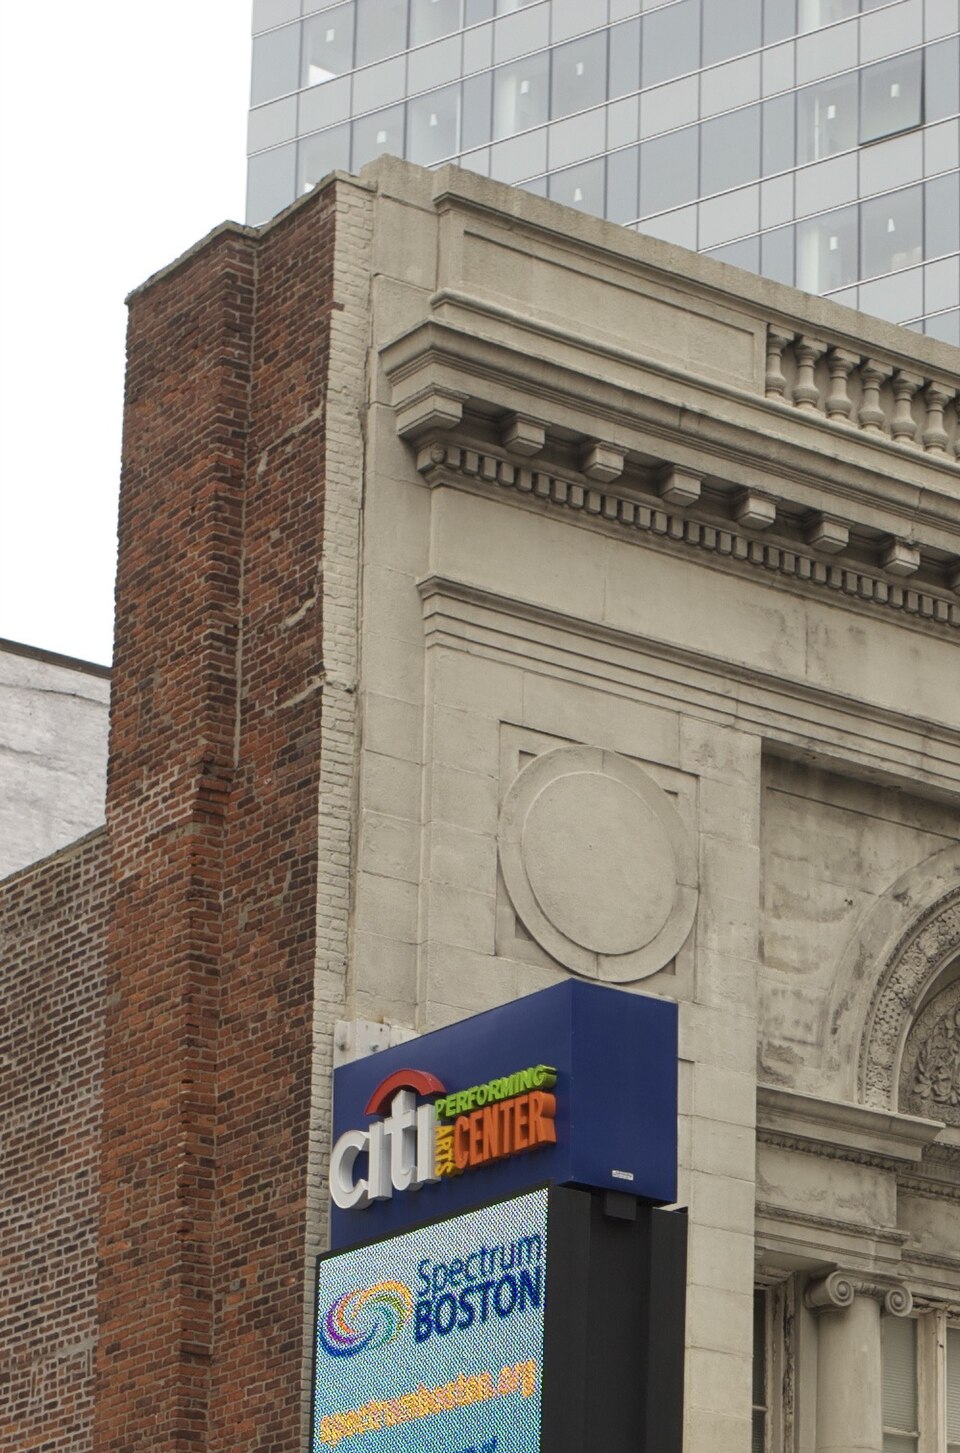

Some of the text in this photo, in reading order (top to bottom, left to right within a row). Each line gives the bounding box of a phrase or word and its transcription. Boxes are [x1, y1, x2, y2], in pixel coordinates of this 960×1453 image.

[435, 1064, 556, 1120] PERFORMING
[329, 1089, 441, 1210] citi
[434, 1125, 457, 1177] ARTS
[454, 1090, 557, 1170] CENTER
[416, 1234, 542, 1297] Spectrum
[413, 1265, 544, 1344] BOSTON
